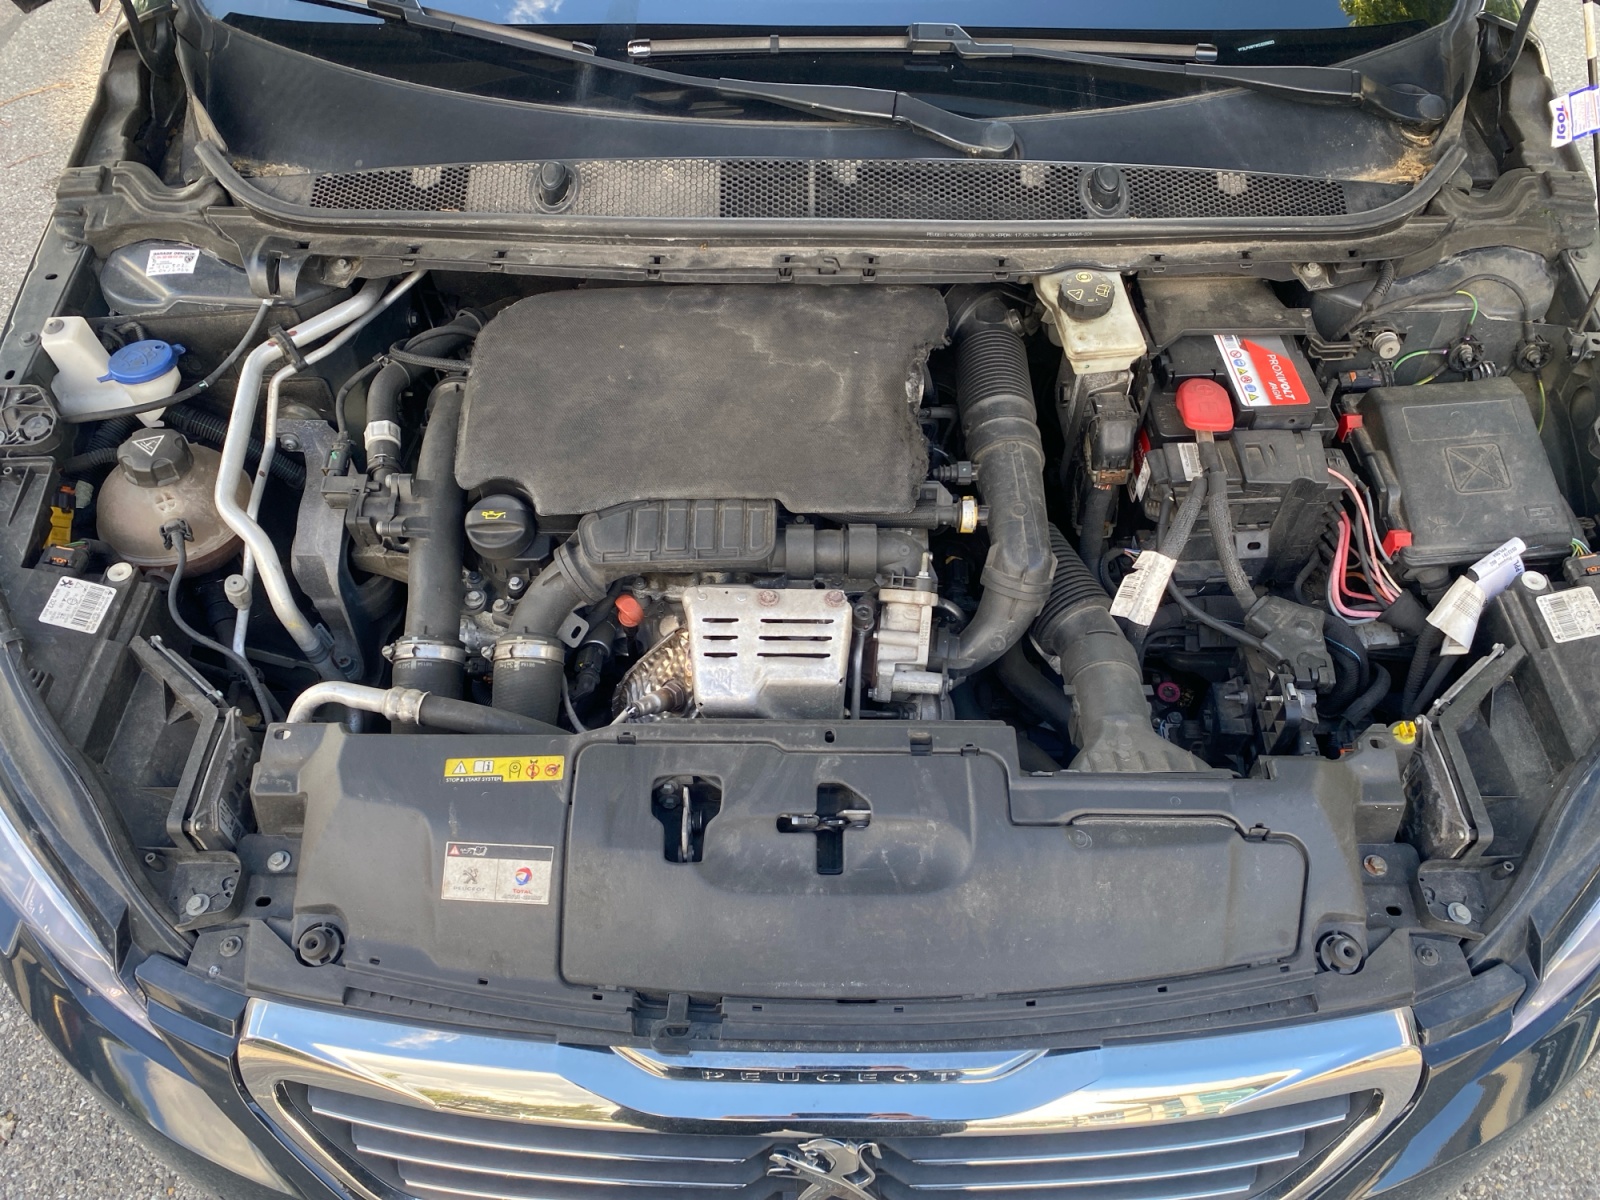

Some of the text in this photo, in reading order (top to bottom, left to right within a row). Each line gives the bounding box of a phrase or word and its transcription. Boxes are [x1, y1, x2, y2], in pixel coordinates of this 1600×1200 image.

[1556, 105, 1566, 139] IGOL
[1267, 354, 1296, 400] PROXIVOLT
[702, 1070, 957, 1083] PEUGEOT
